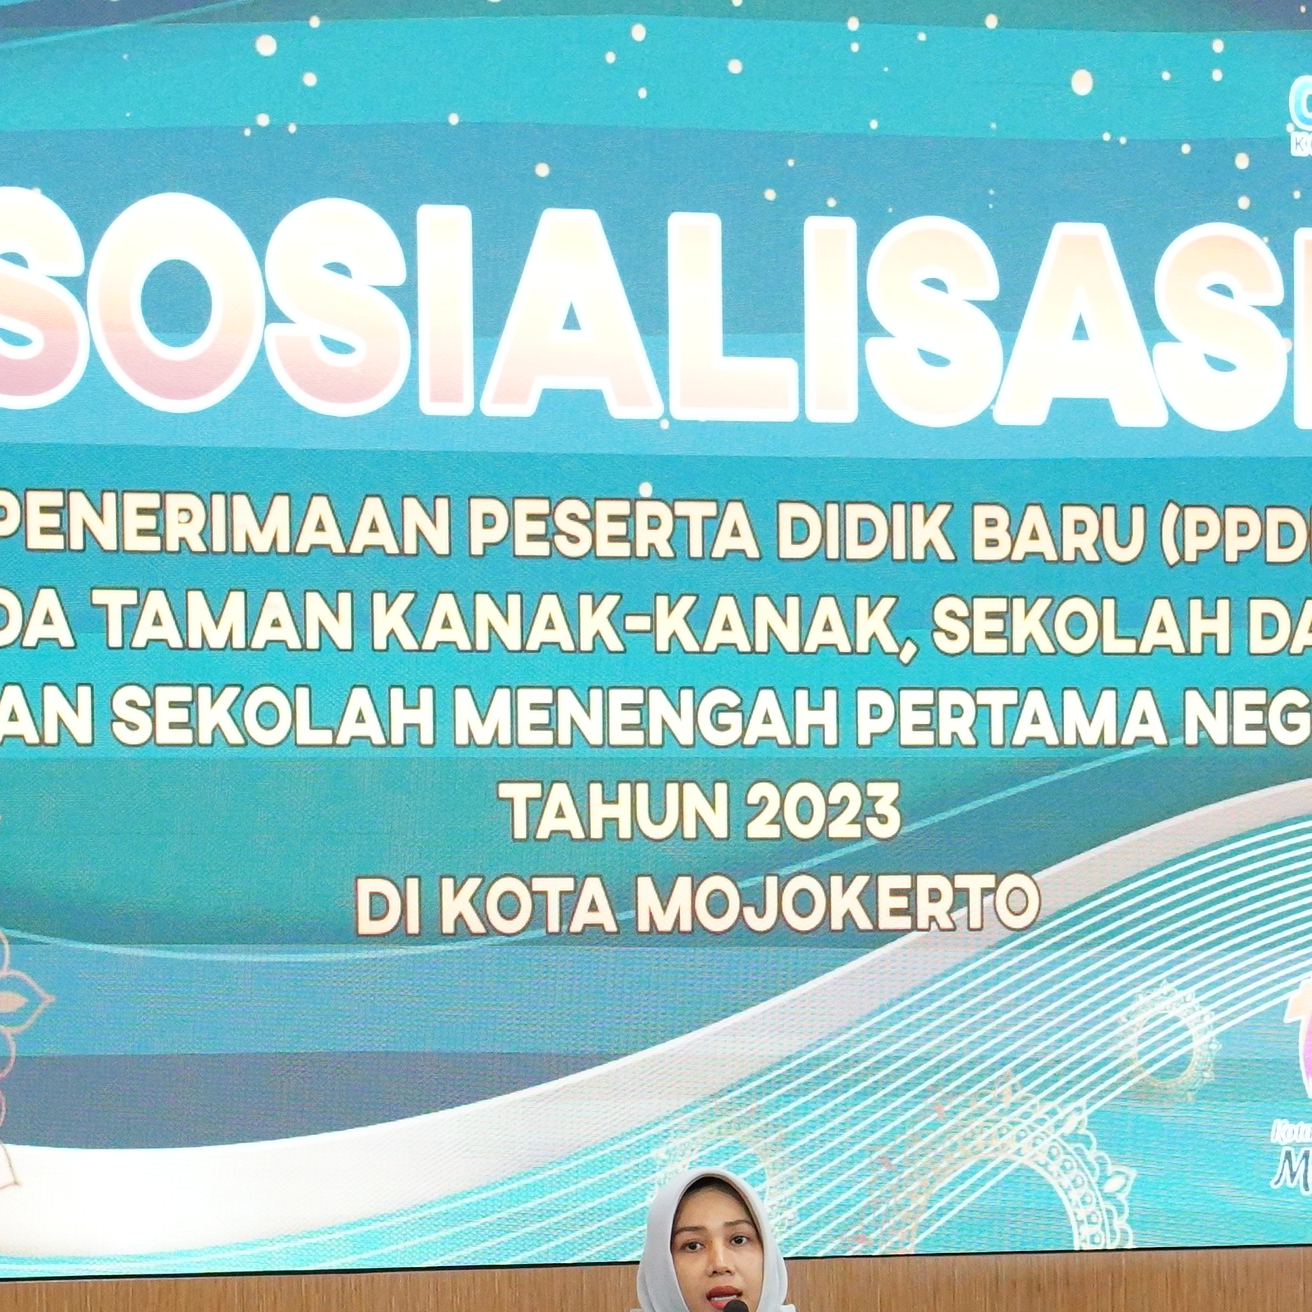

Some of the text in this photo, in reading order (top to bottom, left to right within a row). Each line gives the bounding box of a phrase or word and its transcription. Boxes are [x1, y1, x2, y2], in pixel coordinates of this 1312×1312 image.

[468, 496, 761, 560] PESERTA
[776, 500, 956, 562] DIDIK
[972, 503, 1145, 563] BARU
[90, 587, 354, 651] TAMAN
[371, 590, 918, 665] KANAK-KANAK,
[931, 595, 1231, 655] SEKOLAH
[110, 684, 434, 746] SEKOLAH
[453, 686, 838, 747] MENENGAH
[855, 688, 1169, 747] PERTAMA
[496, 780, 902, 840] TAHUN 2023
[355, 872, 1043, 936] DI KOTA MOJOKERTO
